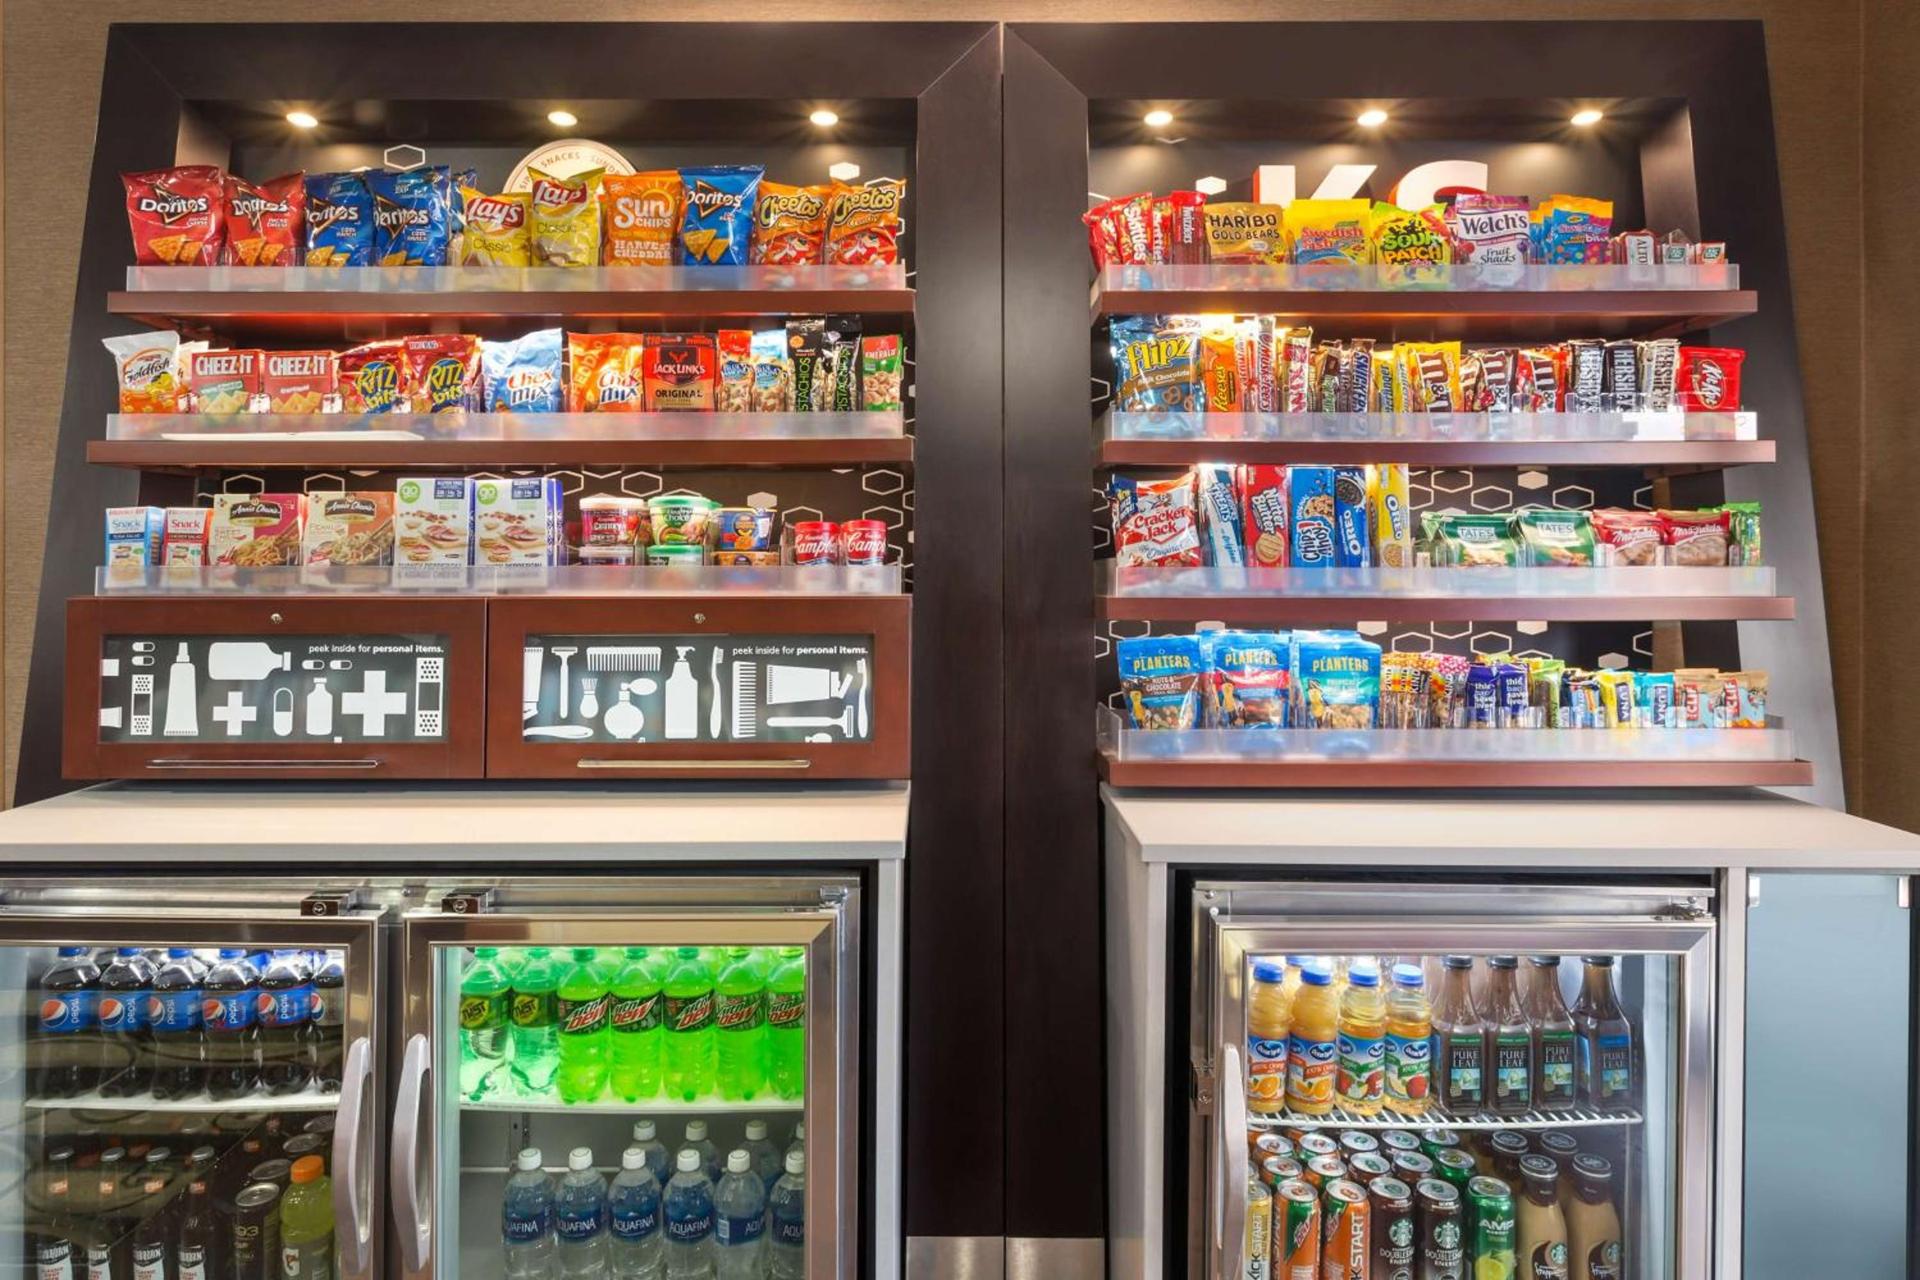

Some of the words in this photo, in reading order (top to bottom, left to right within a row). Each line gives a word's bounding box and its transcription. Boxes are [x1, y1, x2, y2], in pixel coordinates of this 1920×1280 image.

[541, 151, 581, 168] SNACKS
[139, 198, 209, 214] Doritos
[231, 198, 289, 216] Doritos
[685, 191, 743, 207] Doritos
[832, 187, 897, 225] Cheetos
[466, 197, 521, 224] Lay's
[614, 197, 674, 229] Sun
[759, 192, 826, 228] Cheetos
[635, 218, 672, 228] CHIPS
[1209, 213, 1278, 229] HARIBO
[1460, 212, 1529, 236] Welch's
[1123, 202, 1149, 261] Skittles
[1211, 231, 1241, 241] GOLD
[1246, 230, 1280, 240] BEARS
[1384, 247, 1443, 264] PATCH
[1480, 254, 1516, 266] Snacks
[1637, 238, 1648, 265] ALTO
[1126, 335, 1192, 377] Flipz
[428, 363, 466, 390] RITZ
[653, 364, 676, 374] JACK
[355, 365, 398, 398] RITZ
[507, 369, 554, 390] Chex
[798, 357, 811, 412] STACHIOS
[1352, 351, 1369, 413] SNICKERS
[655, 389, 703, 399] ORIGINAL
[1288, 366, 1305, 414] WIX
[1208, 484, 1232, 523] TREATS
[1263, 487, 1285, 529] Nutter
[111, 518, 141, 528] Snack
[171, 518, 200, 528] Snack
[1133, 506, 1188, 530] Cracker
[1252, 494, 1275, 535] Butter
[1385, 494, 1403, 541] OREO
[1144, 522, 1179, 541] Jack
[1343, 509, 1361, 556] OREO
[308, 644, 330, 655] peek
[331, 644, 356, 654] inside
[358, 644, 371, 654] for
[372, 644, 414, 655] personal
[415, 644, 444, 654] items.
[732, 645, 754, 657] peek
[755, 645, 780, 656] inside
[781, 645, 795, 656] for
[796, 645, 837, 657] personal
[838, 645, 869, 655] items.
[1133, 655, 1191, 673] PLANTERS
[1312, 655, 1369, 673] PLANTERS
[71, 998, 80, 1024] pepsi
[127, 997, 136, 1024] pepsi
[167, 999, 175, 1025] pepsi
[228, 999, 238, 1024] pepsi
[280, 993, 289, 1020] pepsi
[1452, 1050, 1479, 1059] PURE
[1452, 1059, 1478, 1067] LEAF
[1500, 1050, 1526, 1059] PURE
[1500, 1059, 1525, 1067] LEAF
[612, 1216, 655, 1234] AQUAFINA
[669, 1217, 711, 1236] AQUAFINA
[1478, 1219, 1515, 1231] AMP
